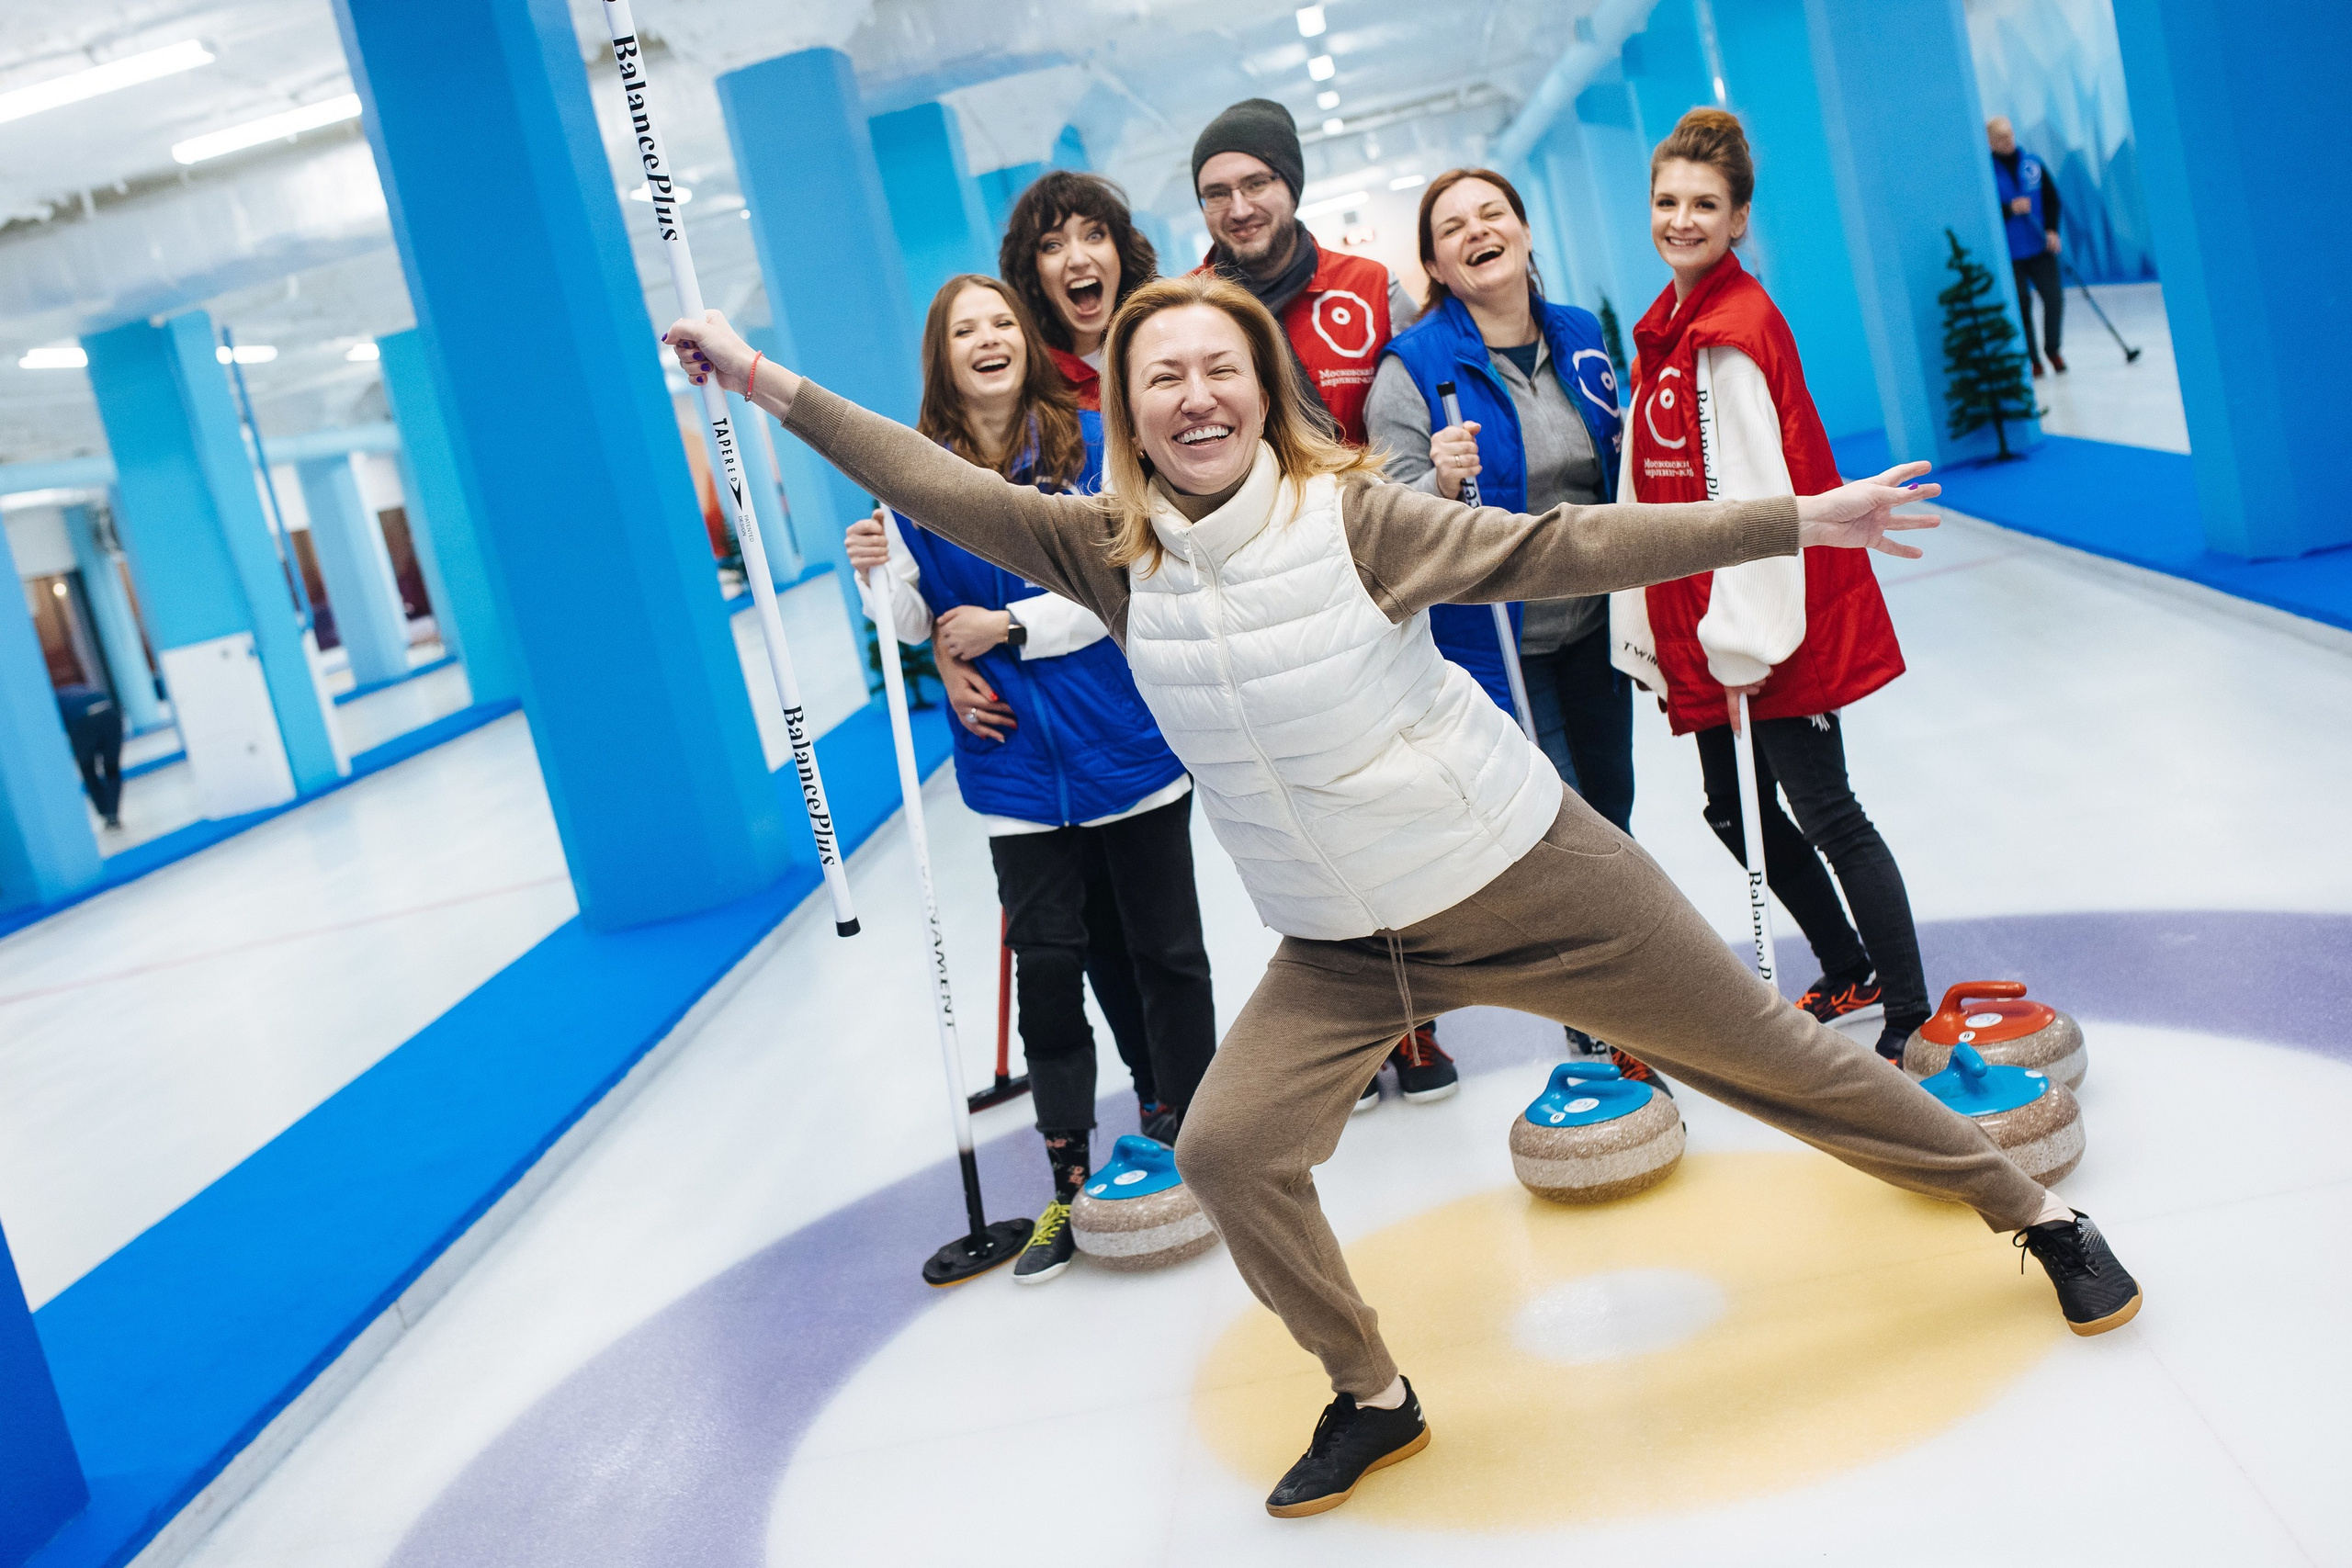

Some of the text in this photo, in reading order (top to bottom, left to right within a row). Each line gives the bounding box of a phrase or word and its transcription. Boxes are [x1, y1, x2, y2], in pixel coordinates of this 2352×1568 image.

[613, 34, 678, 242] BalancePlus
[712, 417, 738, 482] TAPERED
[738, 515, 747, 536] DESIGN
[744, 514, 754, 543] PATENTED
[783, 705, 835, 865] BalancePlus
[1748, 870, 1773, 981] BalanceP
